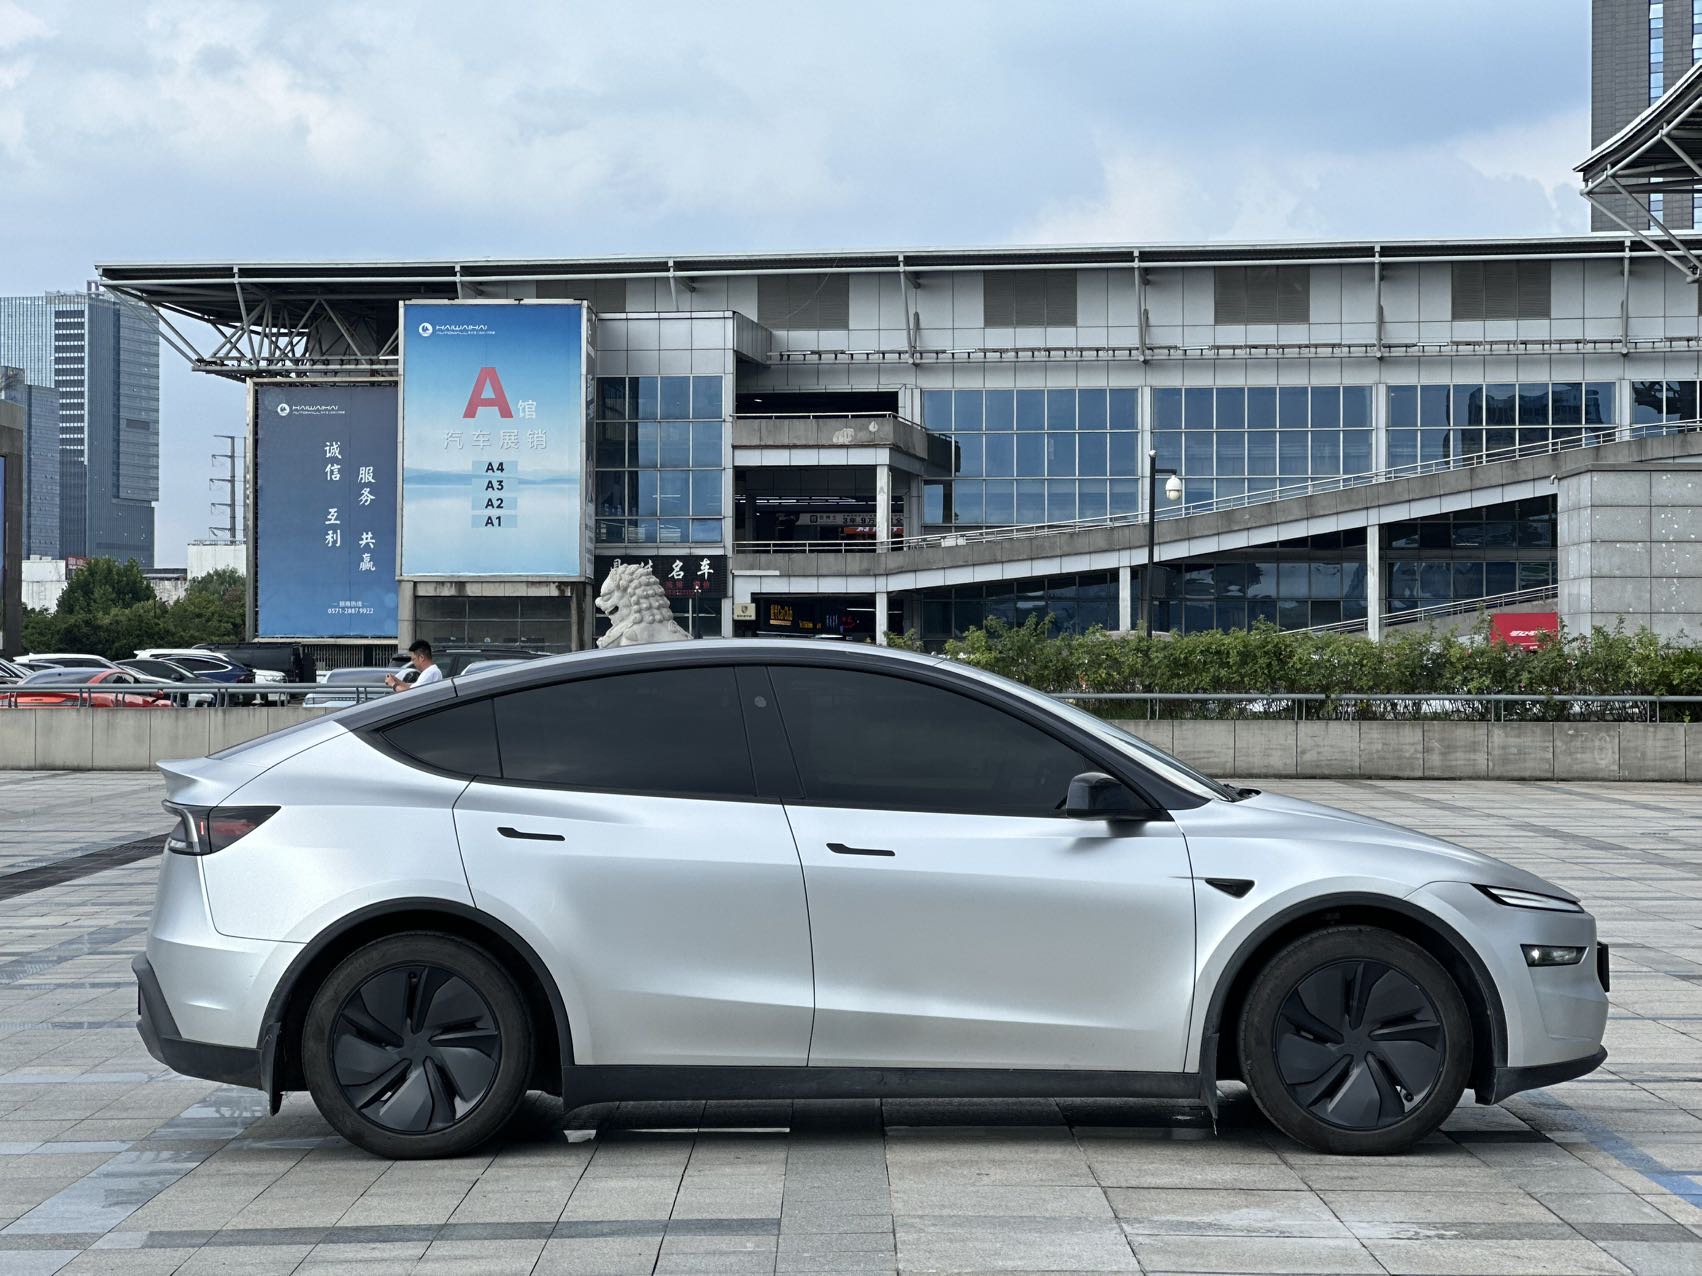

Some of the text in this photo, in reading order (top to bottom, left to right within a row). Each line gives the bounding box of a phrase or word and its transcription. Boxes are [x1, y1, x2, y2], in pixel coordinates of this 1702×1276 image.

[463, 367, 537, 419] A 馆
[444, 428, 548, 450] 汽车展销
[485, 462, 505, 473] A4
[485, 480, 504, 491] A3
[324, 441, 342, 547] 诚信 互利
[485, 498, 504, 509] A2
[357, 466, 376, 571] 服务 共赢
[484, 516, 502, 527] A1
